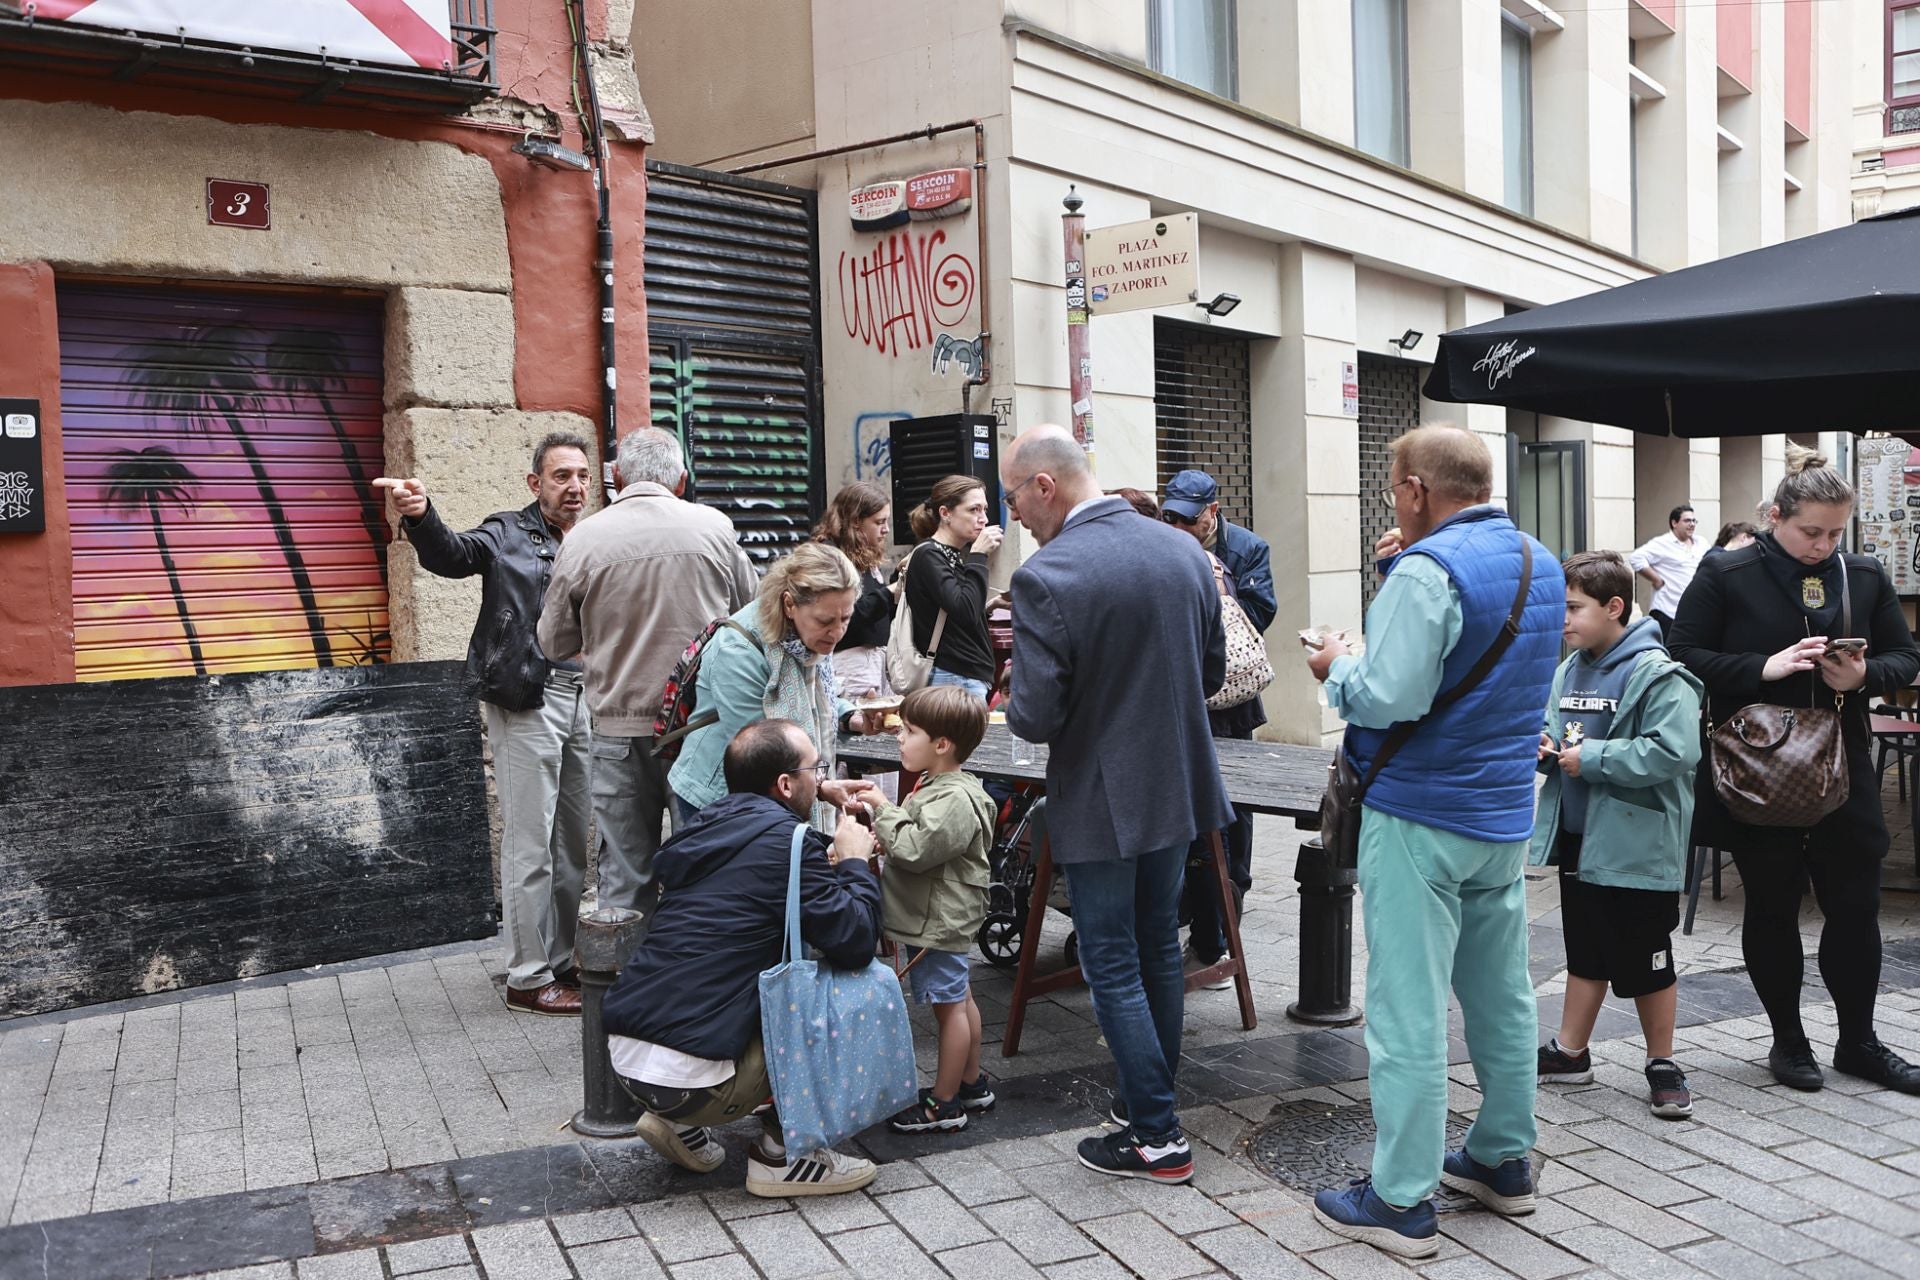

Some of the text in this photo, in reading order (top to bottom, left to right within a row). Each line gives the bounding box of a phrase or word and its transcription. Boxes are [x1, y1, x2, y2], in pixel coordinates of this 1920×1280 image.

[226, 192, 251, 216] 3
[1118, 238, 1159, 255] PLAZA
[1092, 252, 1189, 278] FCO. MARTINEZ
[1112, 275, 1168, 294] ZAPORTA
[1472, 338, 1518, 372] Hotel
[1488, 346, 1536, 391] California
